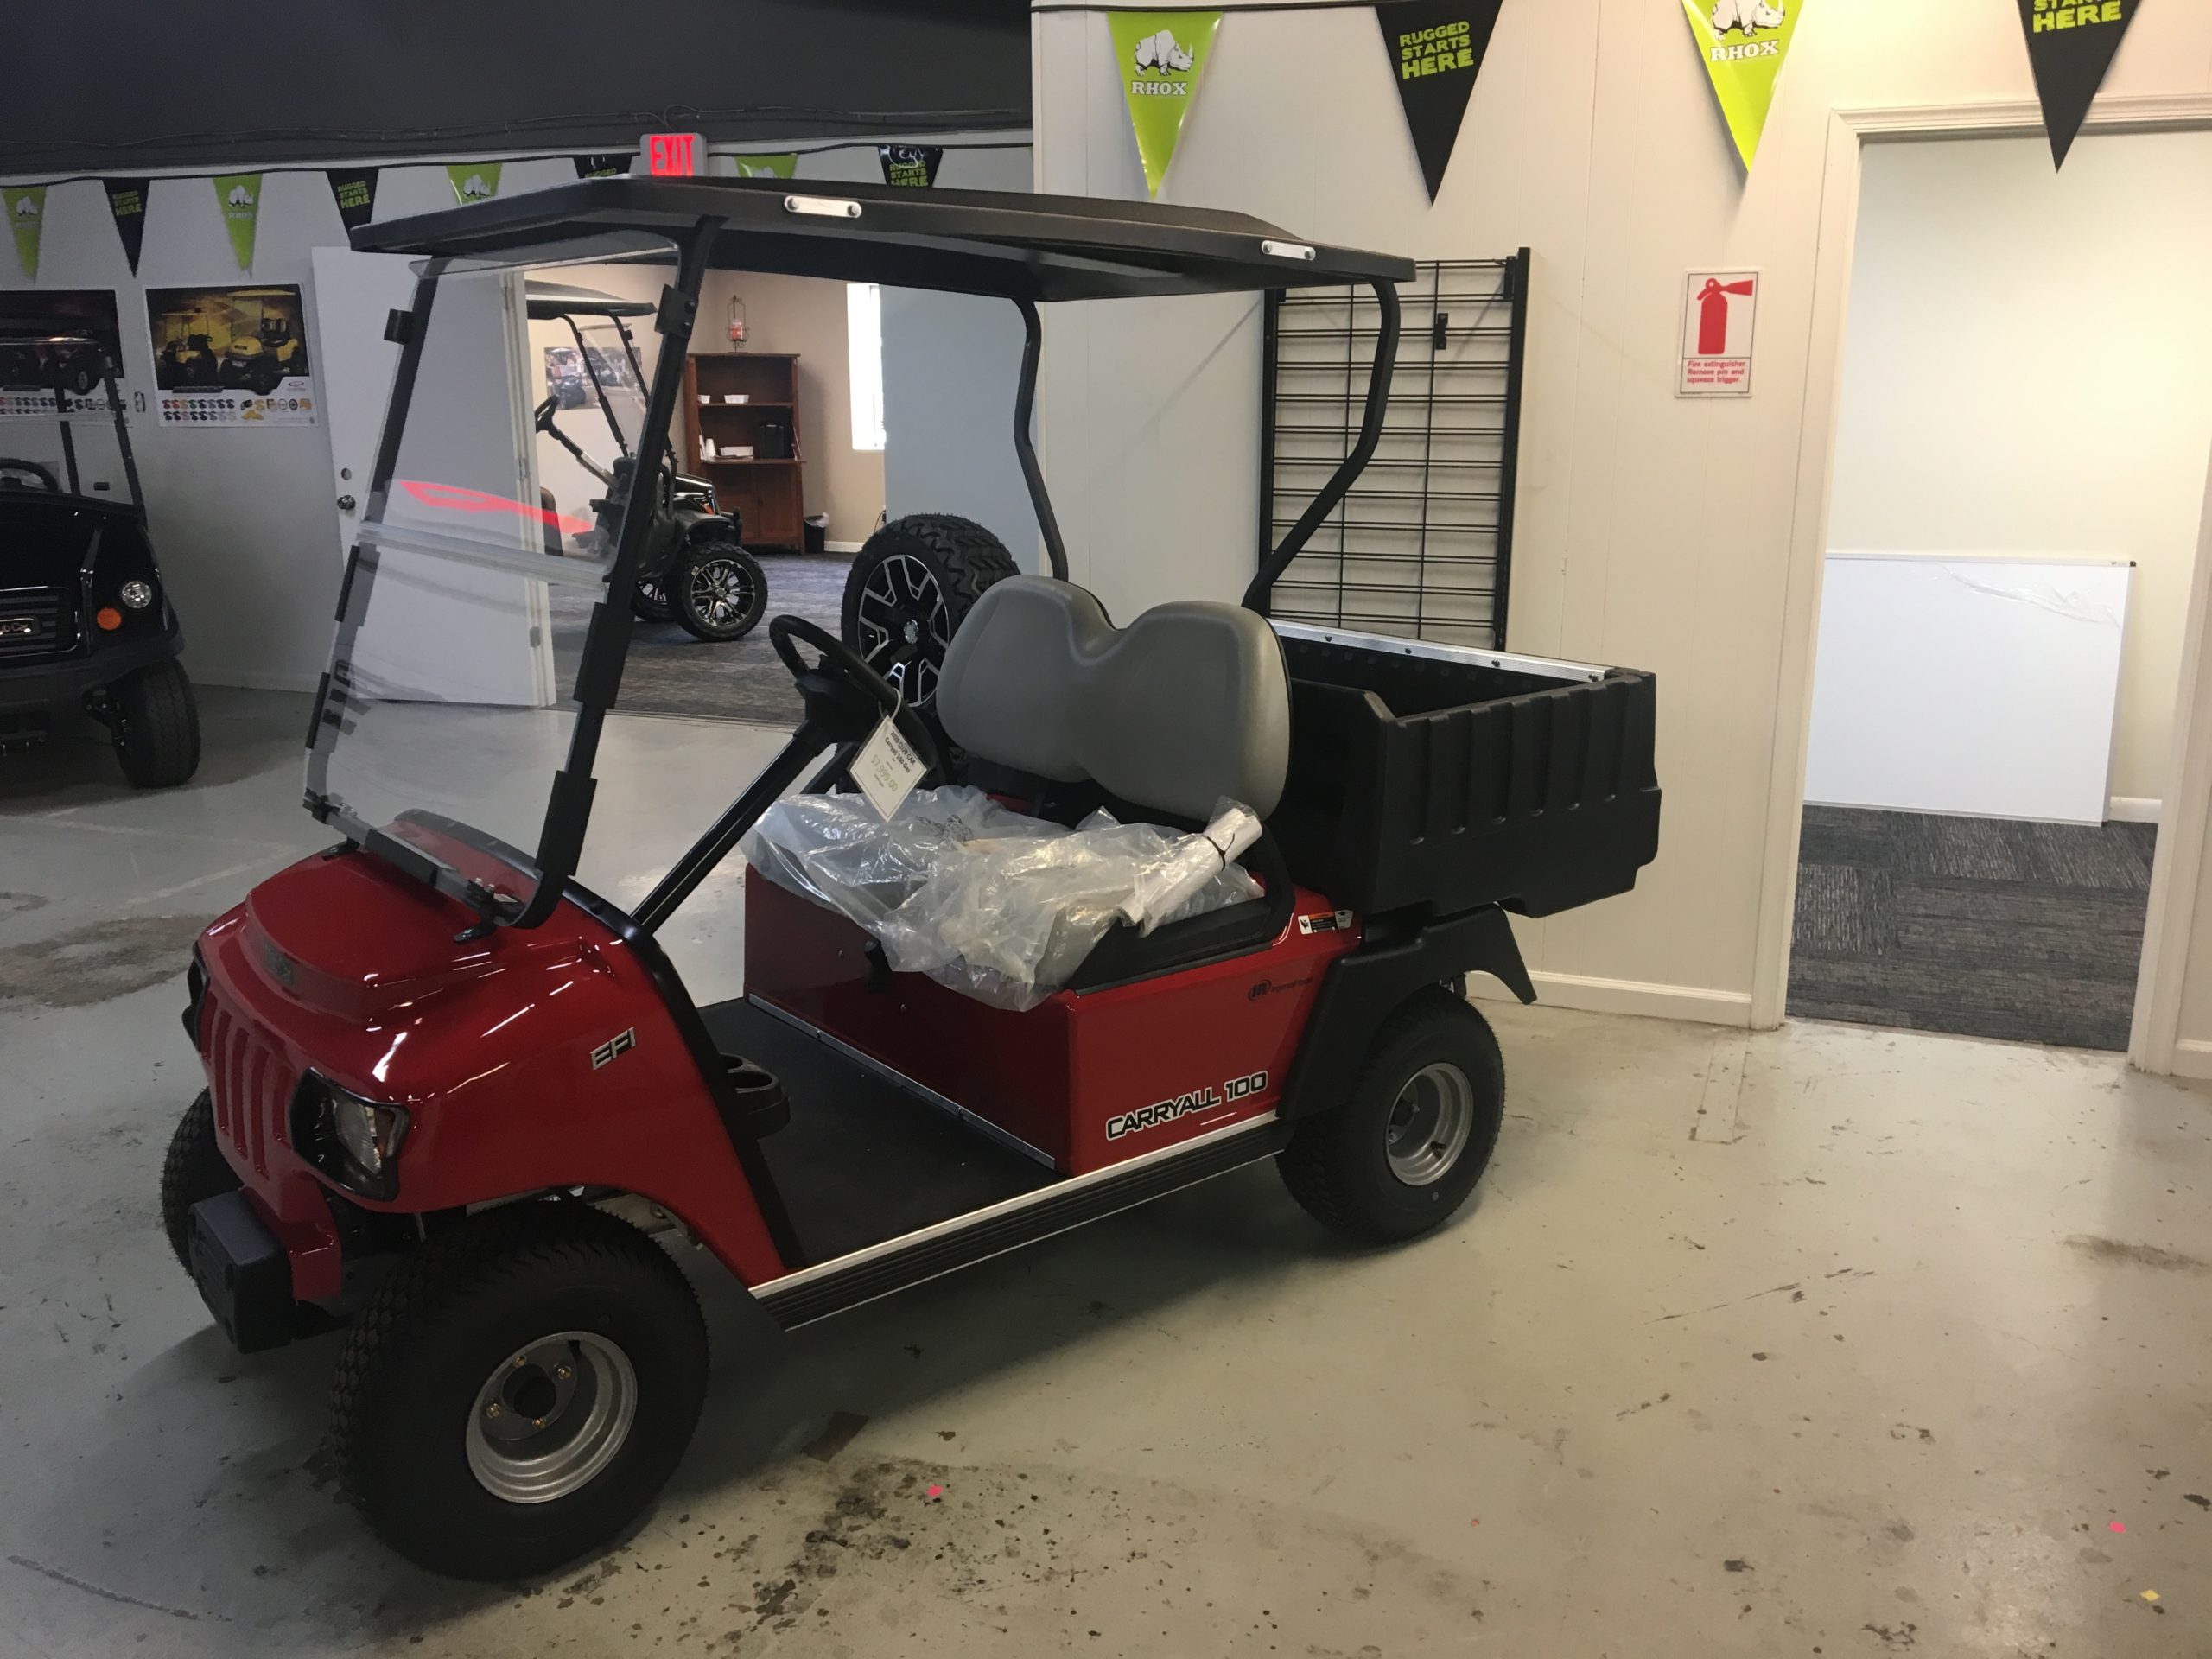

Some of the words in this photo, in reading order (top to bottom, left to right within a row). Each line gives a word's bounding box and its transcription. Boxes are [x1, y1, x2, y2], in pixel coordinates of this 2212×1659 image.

[2033, 0, 2122, 33] HERE
[1400, 21, 1470, 47] RUGGED
[1402, 35, 1471, 60] STARTS
[1711, 39, 1779, 61] RHOX
[1402, 48, 1474, 79] HERE
[1131, 81, 1187, 95] RHOX
[649, 134, 696, 177] EXIT
[891, 168, 926, 179] STARTS
[339, 187, 367, 200] STARTS
[340, 194, 371, 209] HERE
[898, 741, 908, 755] CLUB
[906, 753, 916, 766] CAR
[590, 1027, 636, 1071] EFI
[1106, 1086, 1221, 1141] CARRYALL
[1224, 1071, 1268, 1102] 100
